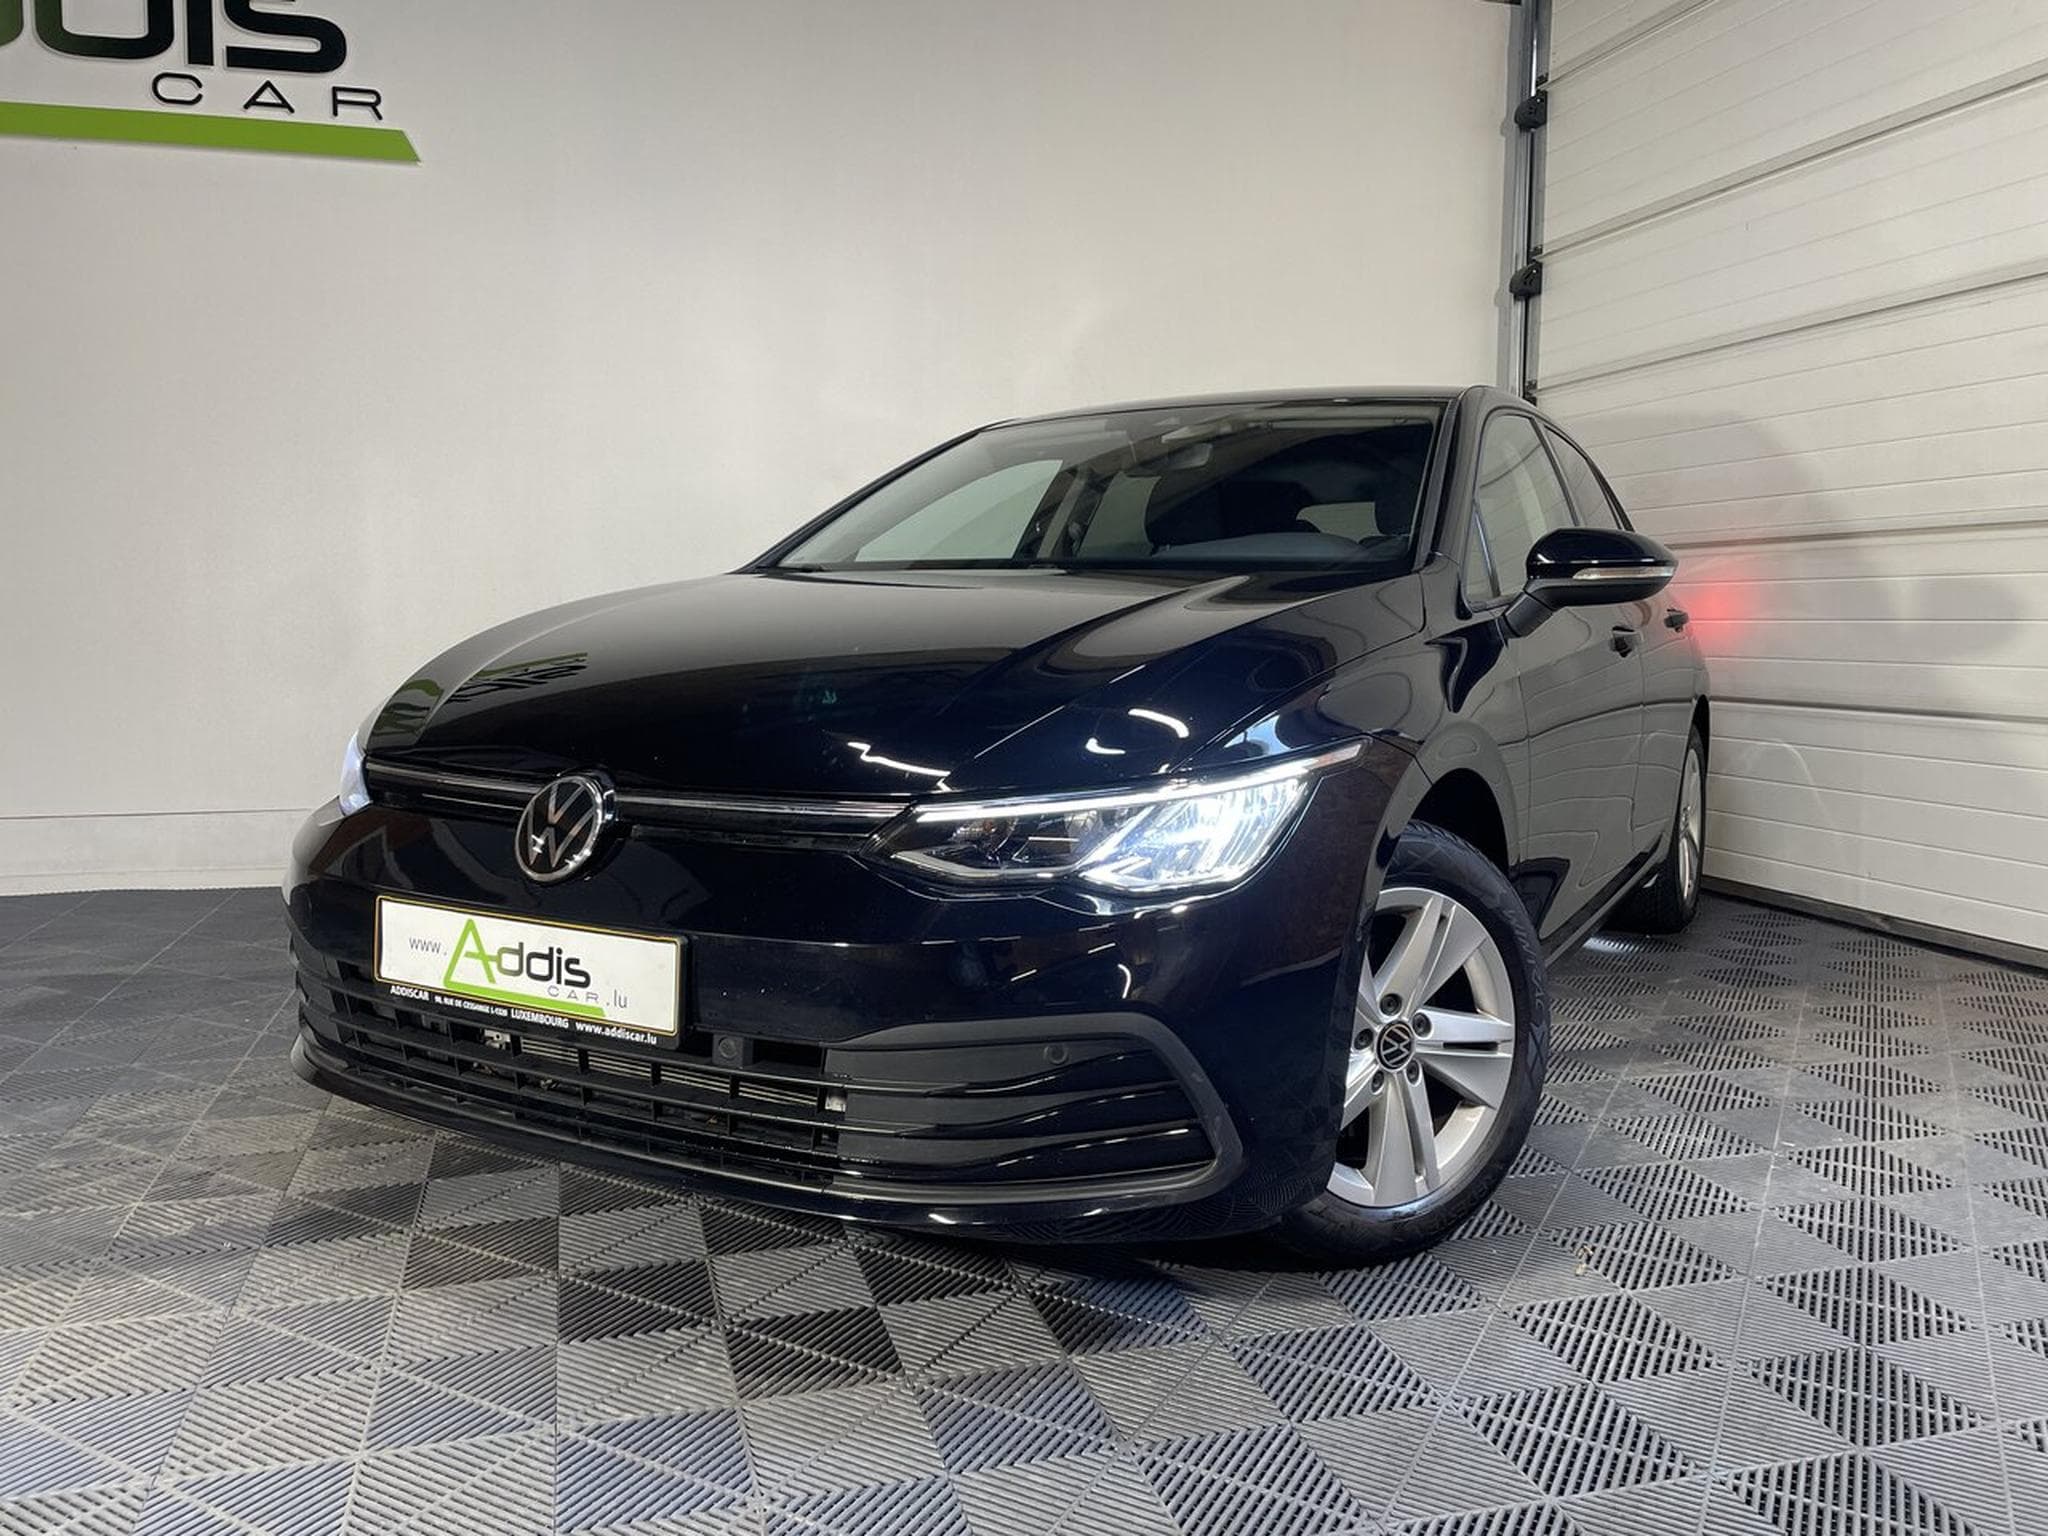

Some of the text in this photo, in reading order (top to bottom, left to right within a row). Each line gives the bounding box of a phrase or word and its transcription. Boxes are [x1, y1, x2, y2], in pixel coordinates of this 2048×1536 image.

[152, 72, 383, 120] CAR
[409, 918, 591, 989] www. Addis
[390, 985, 430, 1001] ADDISCAR
[511, 1007, 569, 1028] LUXEMBOURG
[575, 1022, 657, 1045] www.addiscar.lu
[547, 985, 600, 1004] CAR
